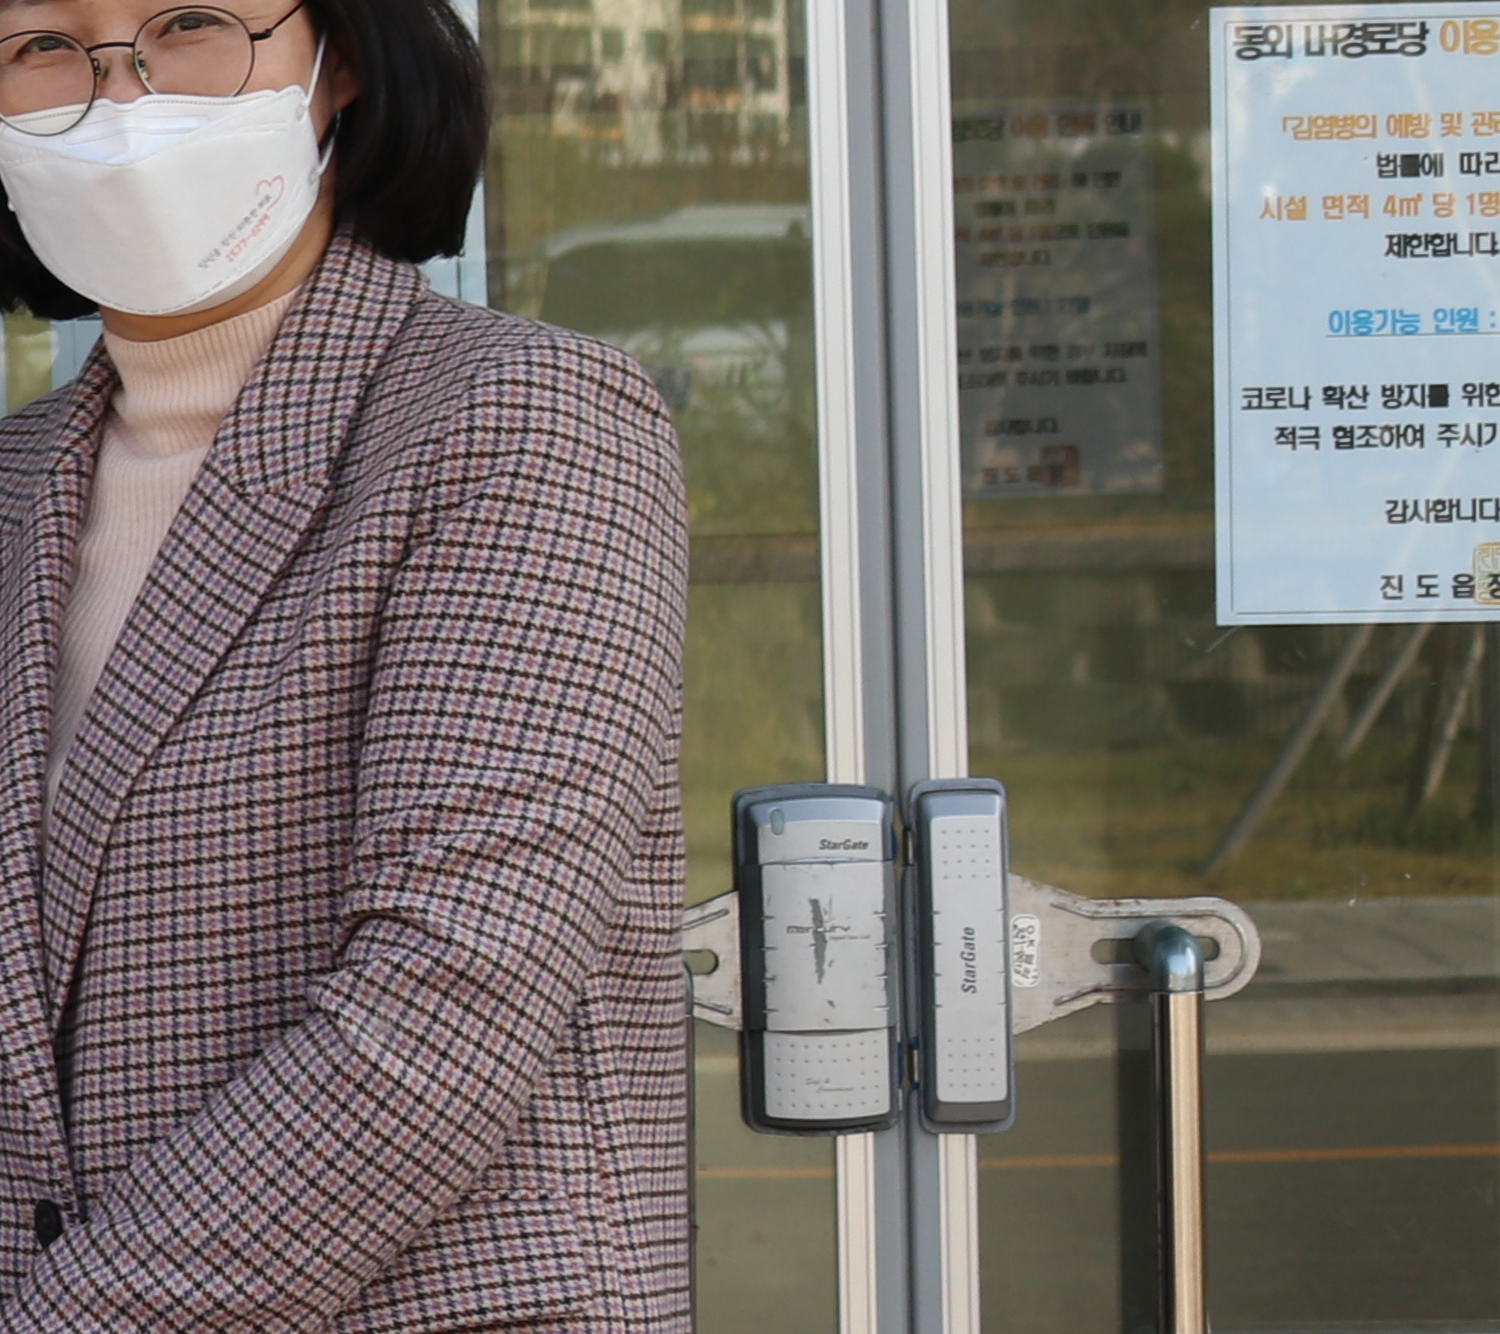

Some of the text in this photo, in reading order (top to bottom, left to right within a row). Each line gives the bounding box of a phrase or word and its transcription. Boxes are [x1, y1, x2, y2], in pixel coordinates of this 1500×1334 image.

[1233, 24, 1293, 61] 동외
[1439, 19, 1499, 56] 이용
[1386, 112, 1432, 139] 예방
[1439, 111, 1463, 138] 및
[1259, 195, 1309, 221] 시설
[1322, 194, 1370, 219] 면적
[1432, 191, 1456, 218] 당
[1328, 309, 1421, 336] 이용가능
[1433, 307, 1479, 334] 인원
[1241, 386, 1312, 411] 코로나
[1321, 385, 1369, 410] 확산
[1274, 425, 1321, 450] 적극
[1332, 424, 1425, 449] 협조하여
[1380, 574, 1404, 600] 진
[1415, 574, 1440, 599] 도
[1451, 573, 1476, 599] 읍
[818, 838, 869, 851] StarGate
[960, 926, 977, 994] StarGate
